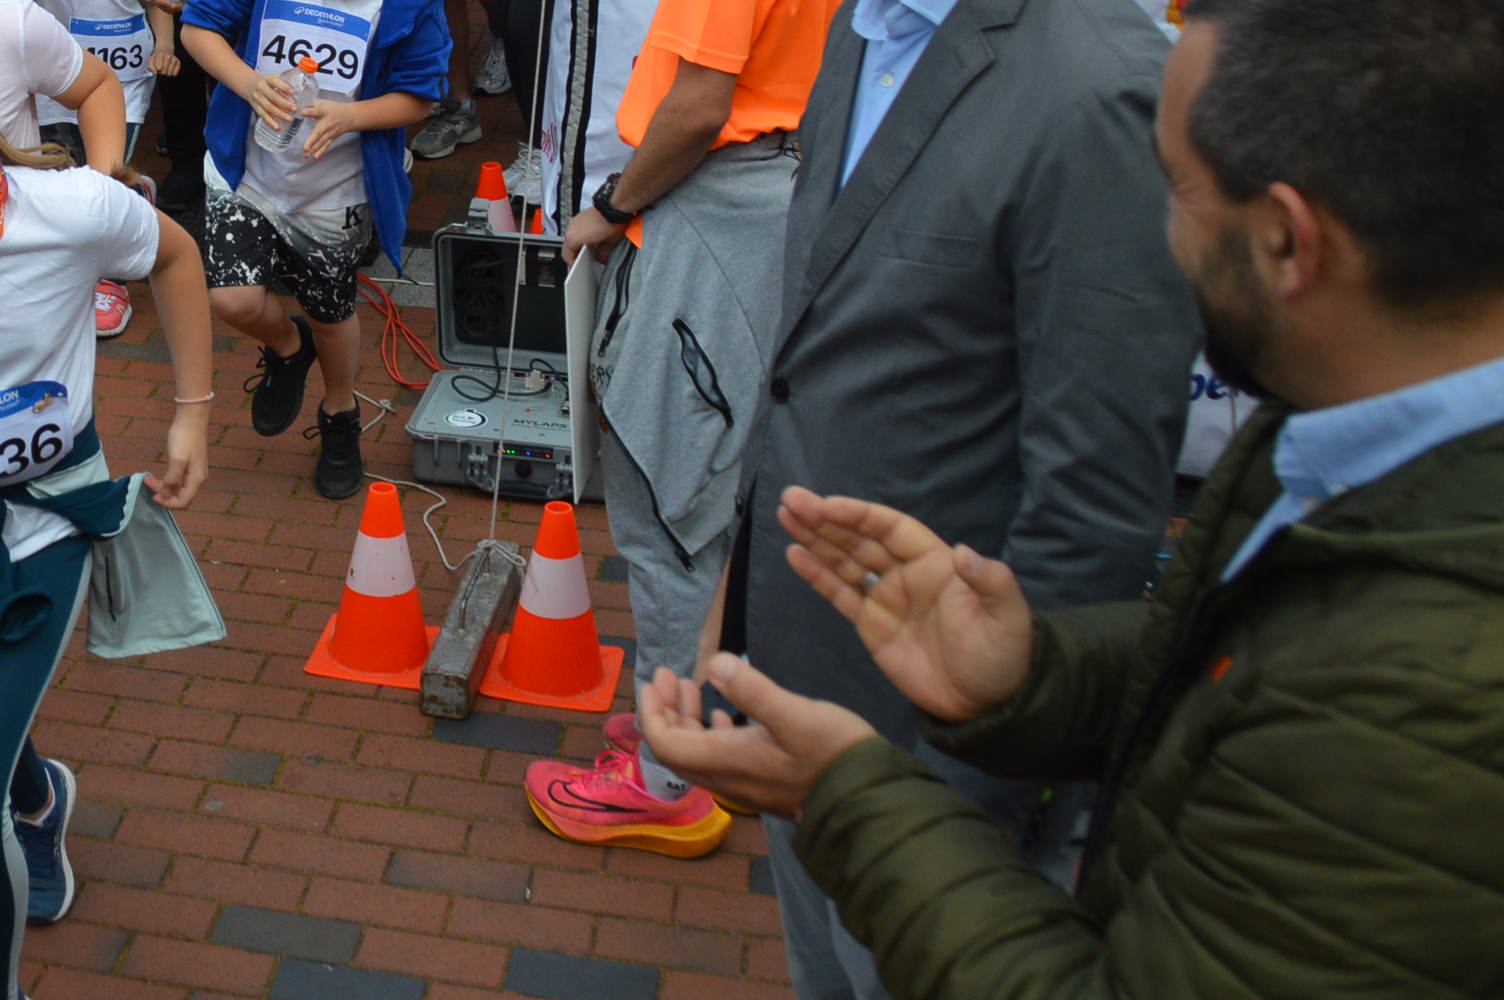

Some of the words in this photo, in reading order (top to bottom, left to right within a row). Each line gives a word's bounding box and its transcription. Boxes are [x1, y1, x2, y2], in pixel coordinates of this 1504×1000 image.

[304, 6, 345, 24] DECATHLON
[262, 34, 360, 80] 4629
[342, 205, 363, 231] K
[512, 418, 568, 429] MYLAPS
